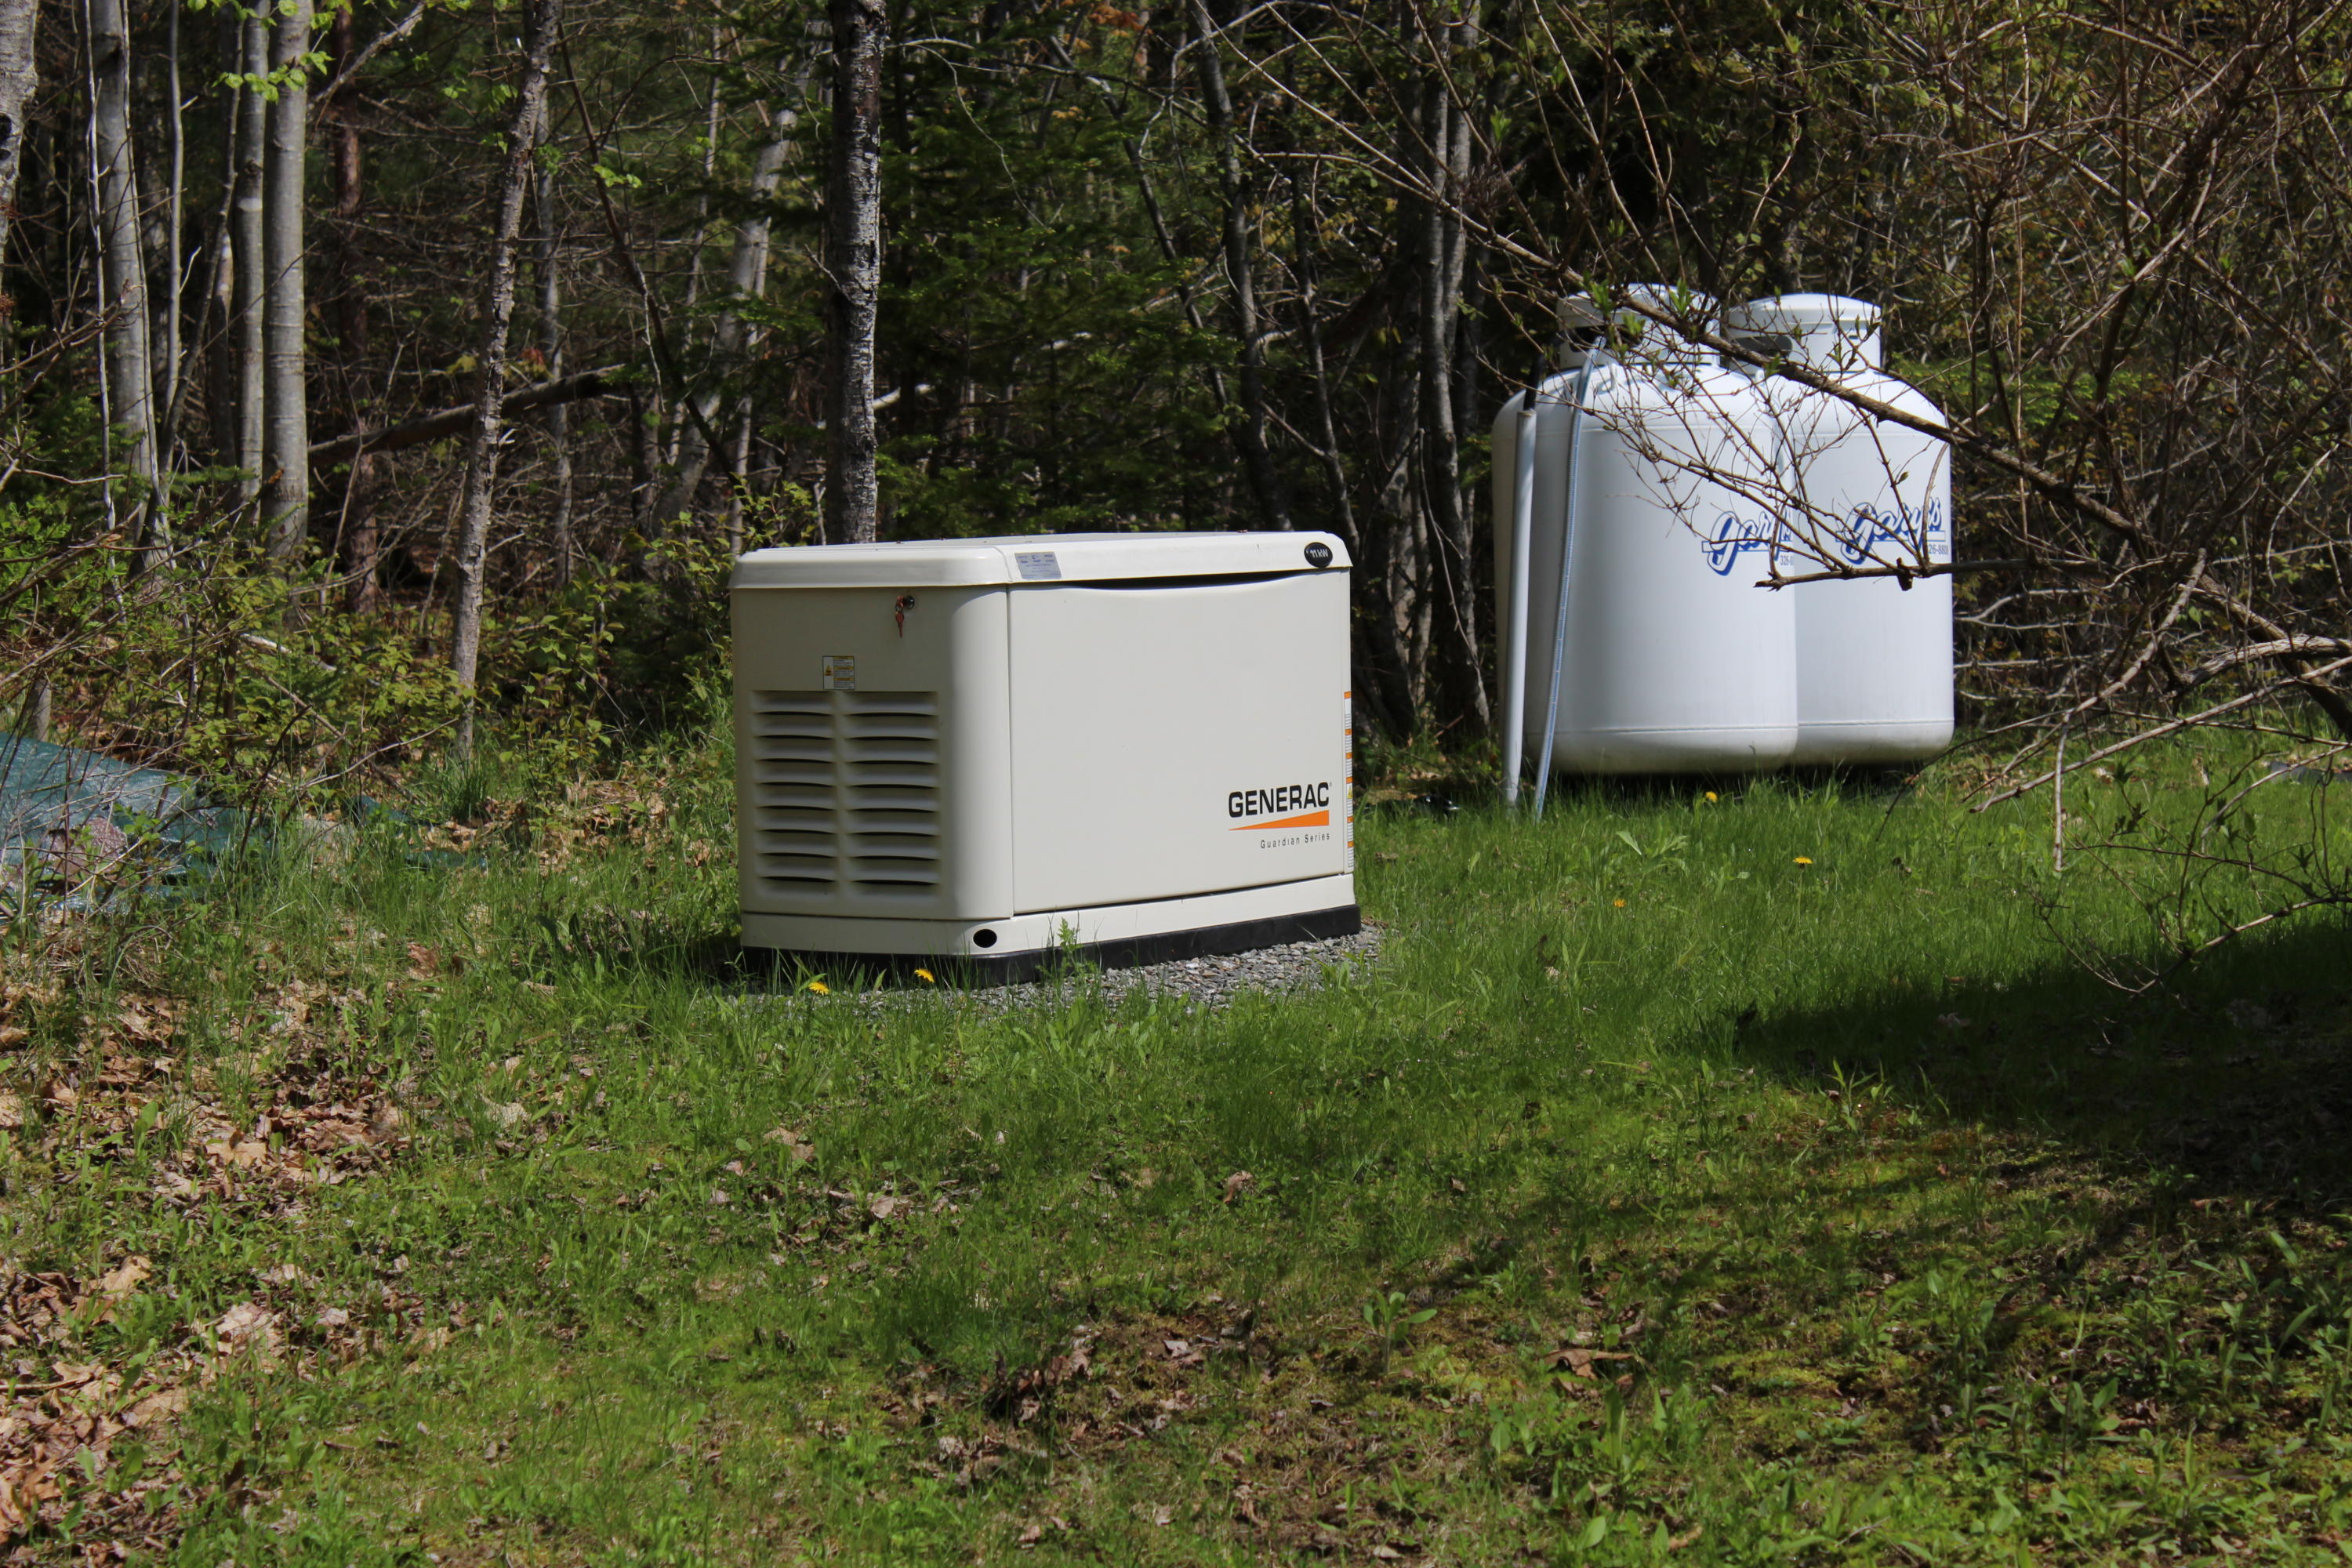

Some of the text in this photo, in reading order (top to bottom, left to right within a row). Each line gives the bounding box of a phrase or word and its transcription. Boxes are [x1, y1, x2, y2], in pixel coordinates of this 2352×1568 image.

[1229, 782, 1329, 818] GENERAC
[1260, 833, 1330, 848] Guardian Series
